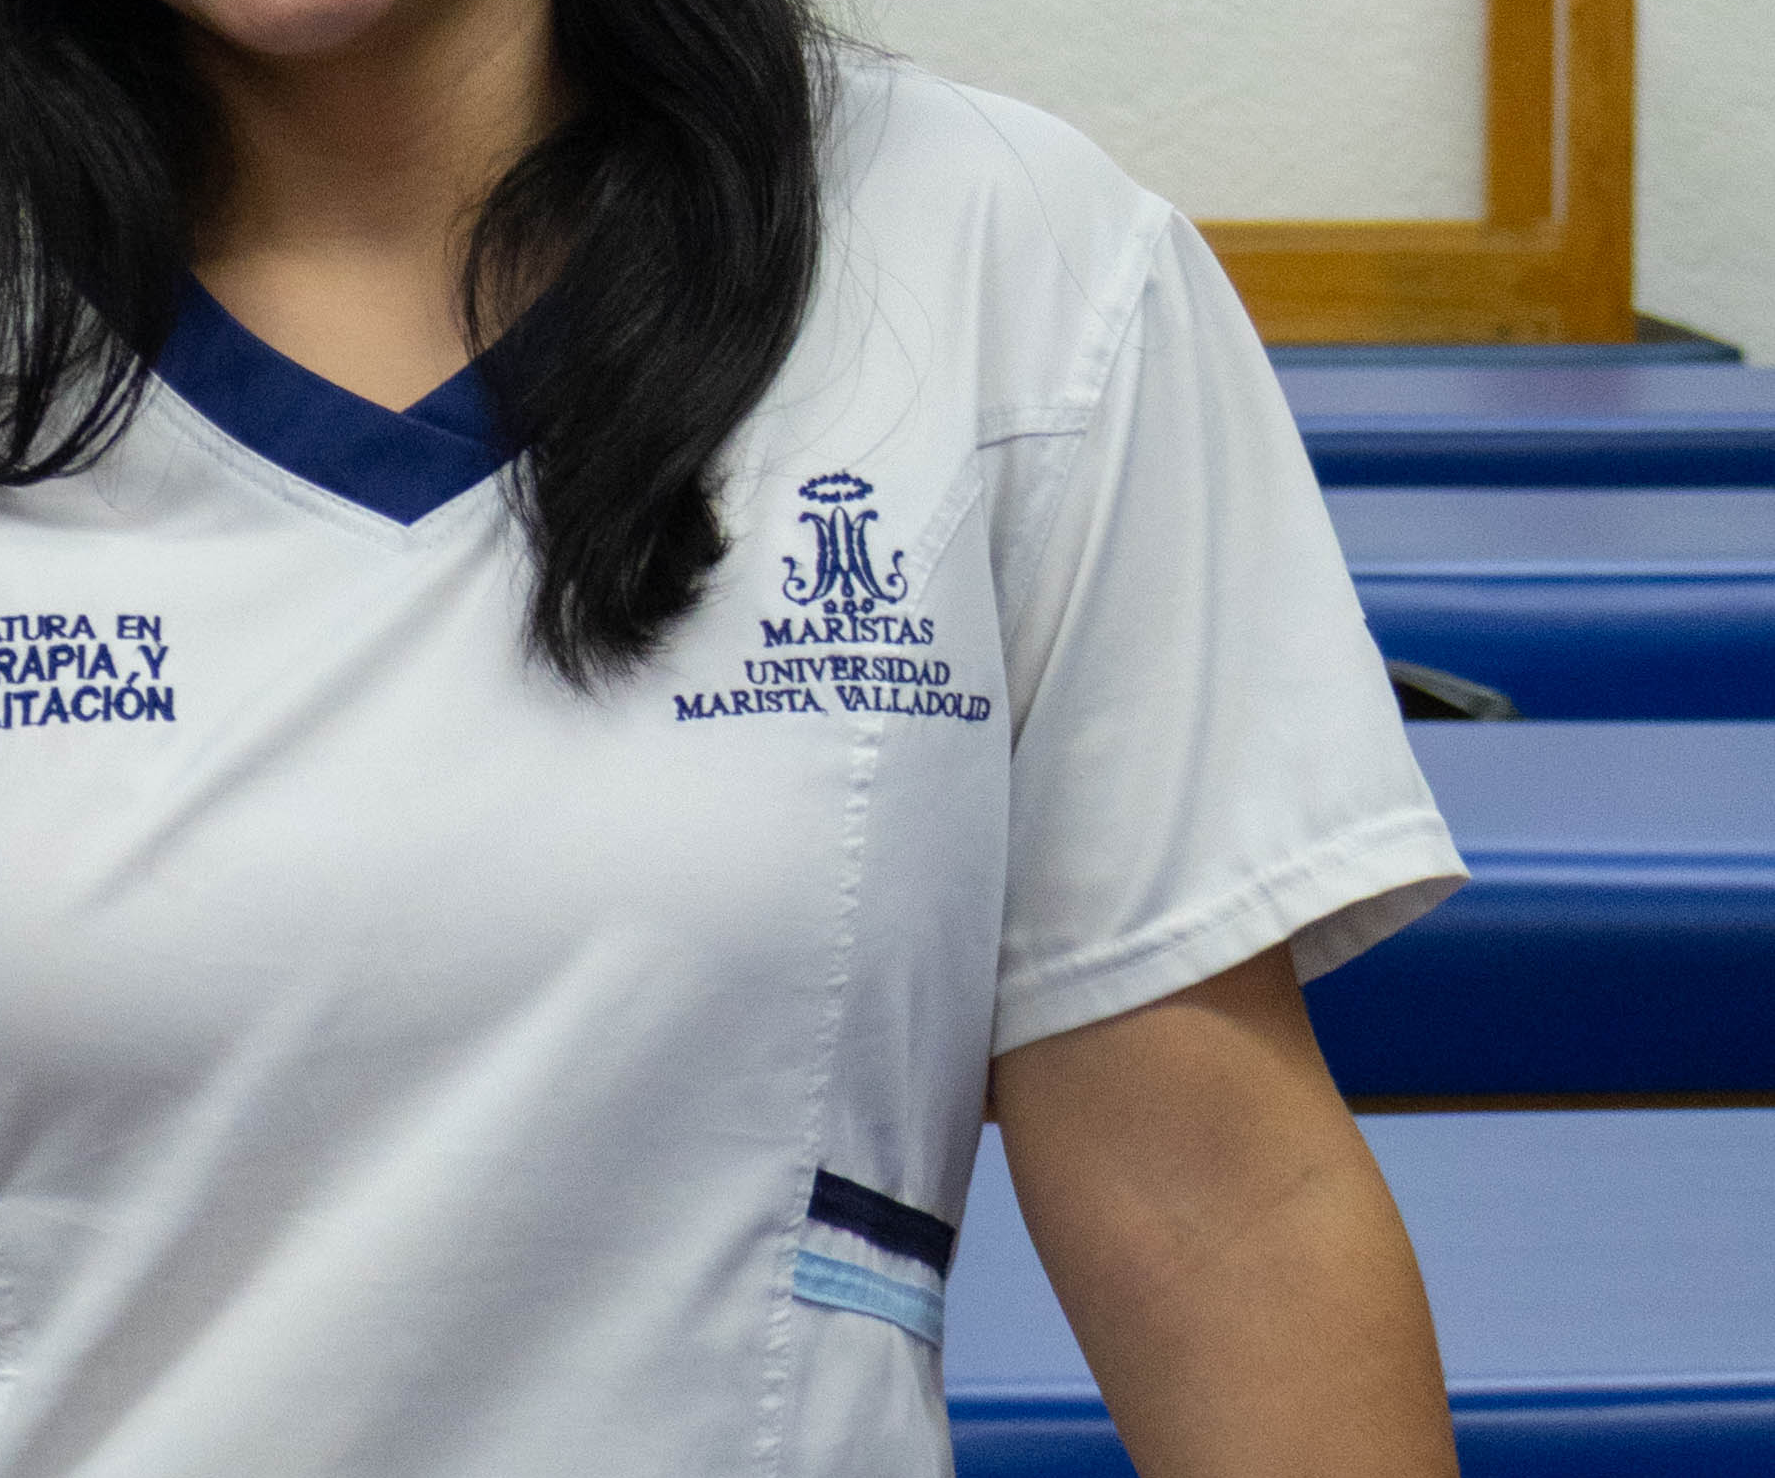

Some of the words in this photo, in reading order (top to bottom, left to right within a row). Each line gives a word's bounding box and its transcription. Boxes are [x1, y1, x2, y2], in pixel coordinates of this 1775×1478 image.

[115, 614, 162, 641] EN
[760, 616, 934, 648] MARISTAS
[137, 645, 169, 680] Y
[744, 655, 951, 686] UNIVERSIDAD
[674, 688, 828, 721] MARISTA
[835, 685, 991, 721] VALLADOLID
